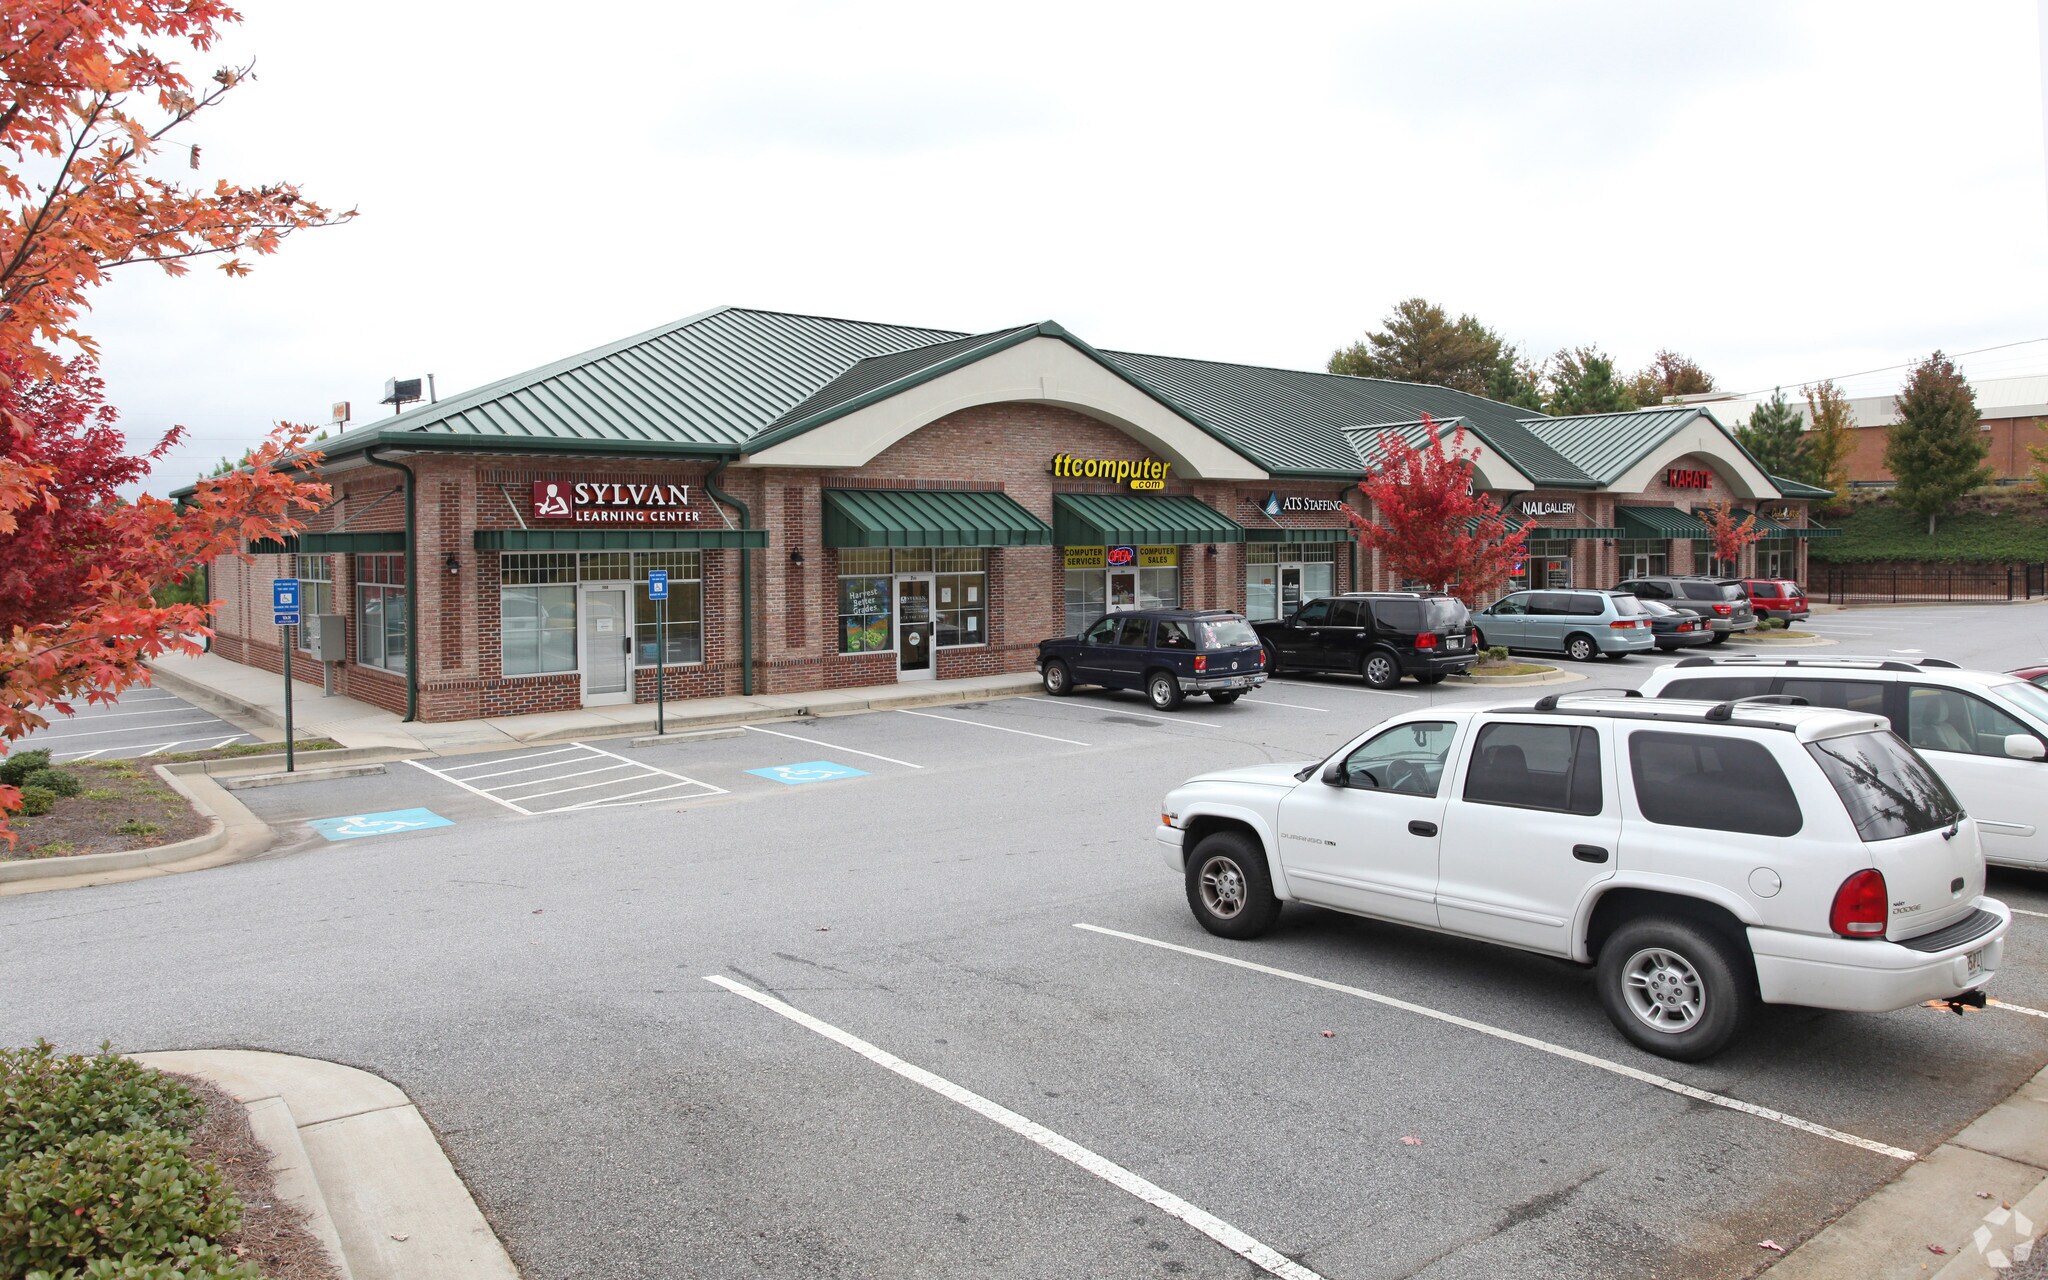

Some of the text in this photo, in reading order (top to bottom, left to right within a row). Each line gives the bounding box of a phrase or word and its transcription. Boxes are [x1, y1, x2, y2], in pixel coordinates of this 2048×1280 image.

[1055, 453, 1171, 484] ttcomputer
[1136, 480, 1161, 489] .com
[1669, 469, 1713, 489] KARATE
[574, 482, 689, 506] SYLVAN
[1283, 497, 1343, 511] ATS STAFFING
[1522, 501, 1576, 515] NAIL GALLERY
[575, 511, 700, 522] LEARNING CENTER
[1064, 548, 1103, 557] COMPUTER
[1108, 550, 1132, 562] OPEN
[1140, 547, 1175, 555] COMPUTER
[1067, 557, 1101, 566] SERVICES
[1147, 556, 1168, 564] SALES
[849, 588, 878, 600] Harvest
[853, 597, 876, 607] Better
[852, 604, 878, 615] Grades
[1280, 832, 1323, 845] DURANGO
[1892, 903, 1921, 915] DODGE
